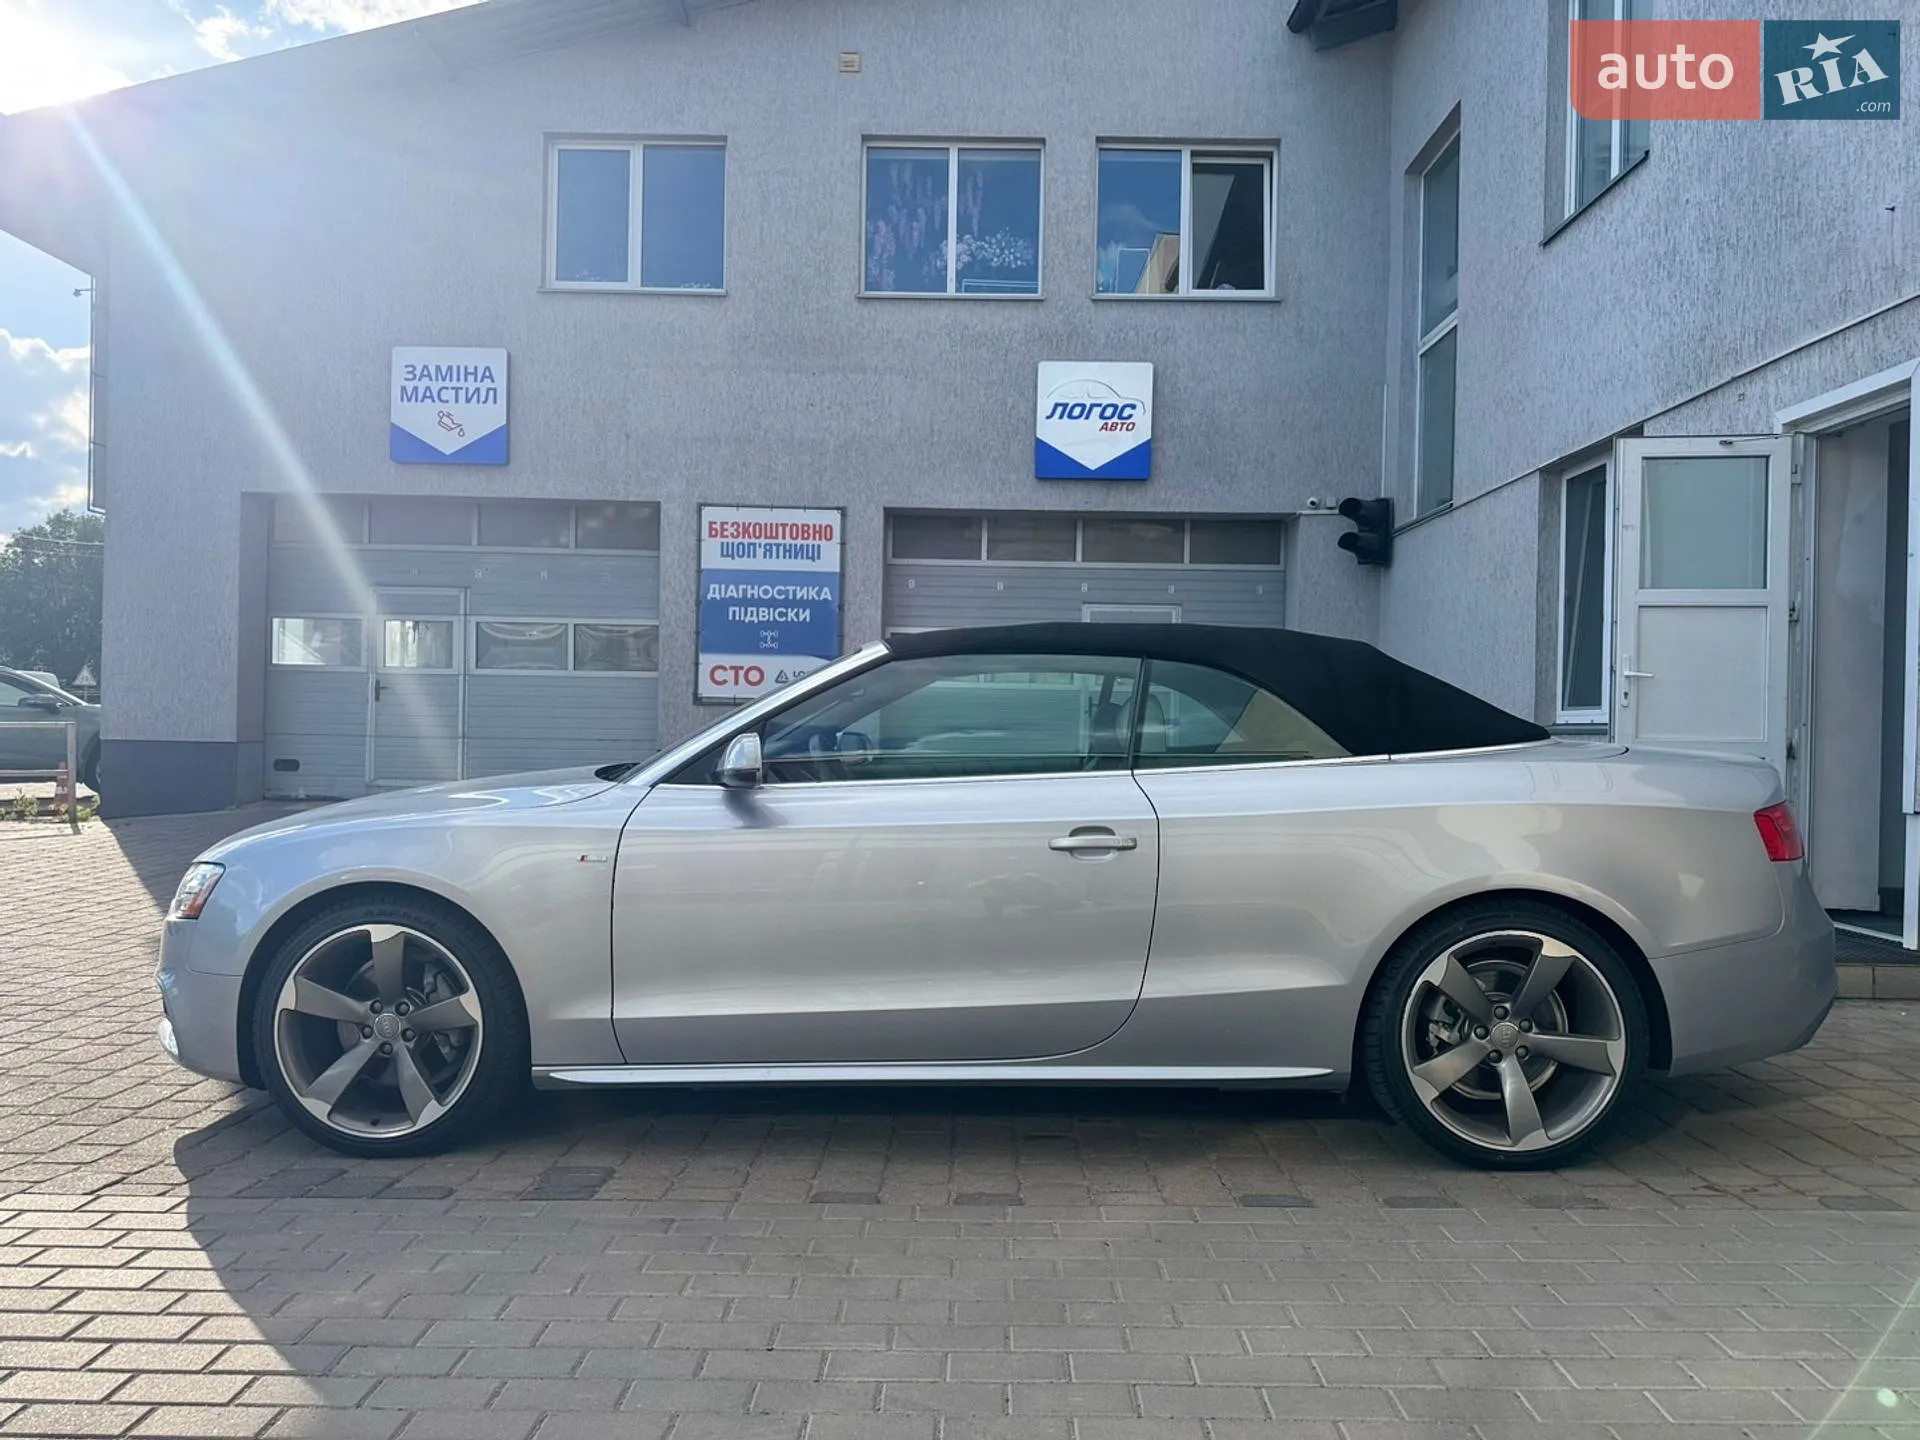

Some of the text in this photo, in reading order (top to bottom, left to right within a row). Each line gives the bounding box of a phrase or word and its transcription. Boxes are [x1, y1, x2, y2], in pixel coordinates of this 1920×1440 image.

[403, 364, 495, 383] ЗАМІНА
[400, 385, 498, 405] МАСТИЛ
[1045, 402, 1137, 420] ЛОГОС
[1098, 421, 1136, 432] АВТО
[708, 520, 833, 541] БЕЗКОШТОВНО
[707, 584, 832, 601] ДІАГНОСТИКА
[728, 606, 811, 623] ПІДВІСКИ
[709, 664, 766, 687] СТО
